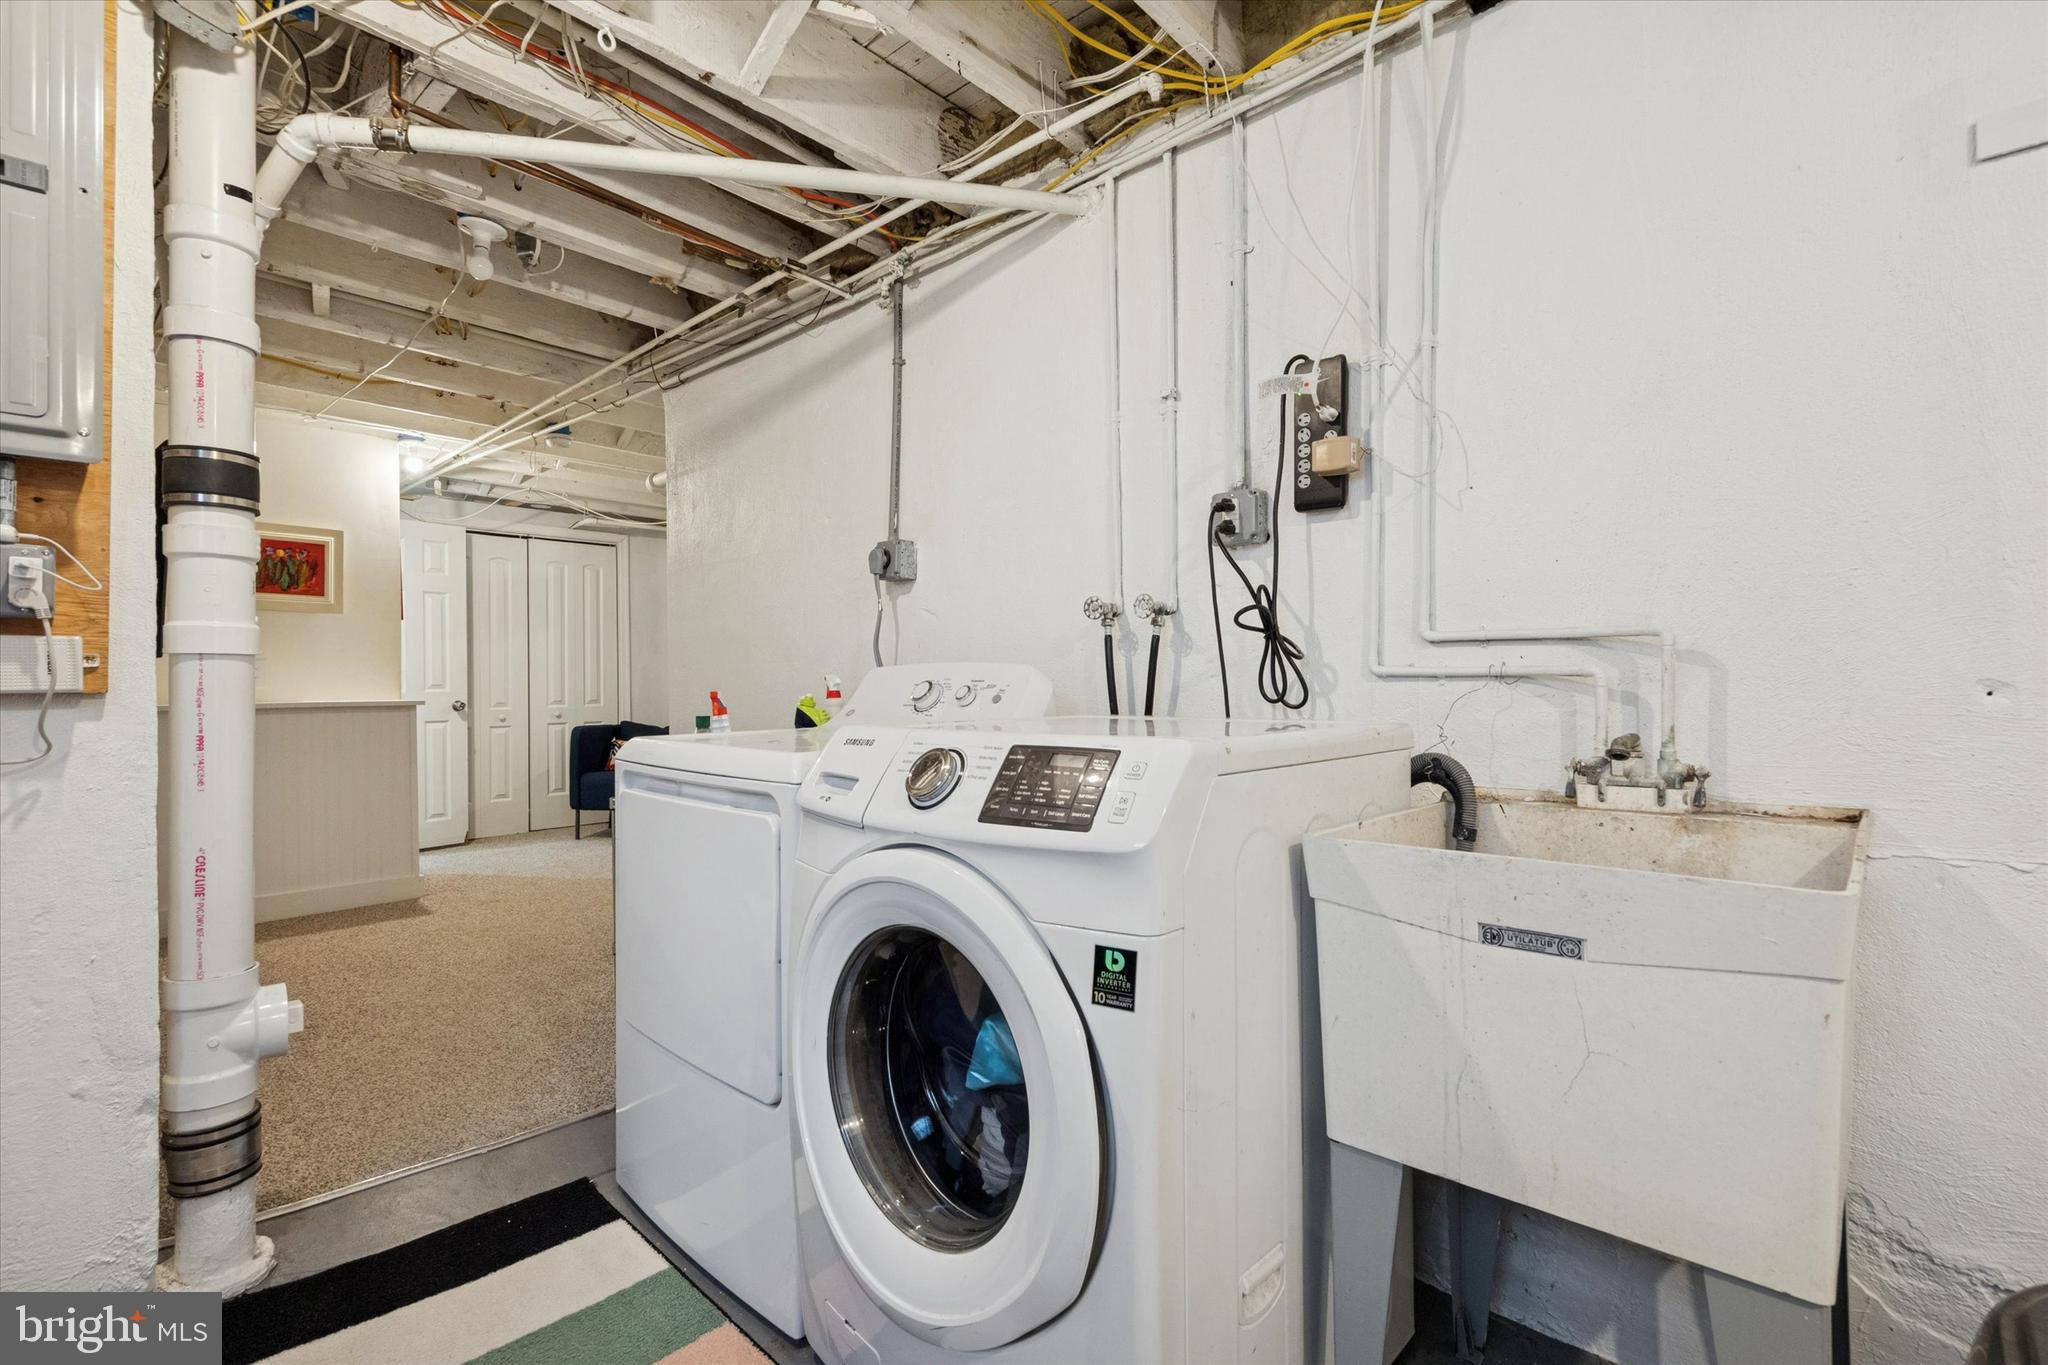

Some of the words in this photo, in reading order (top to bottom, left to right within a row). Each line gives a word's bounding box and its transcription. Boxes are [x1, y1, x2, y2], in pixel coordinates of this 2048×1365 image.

[843, 738, 875, 747] SAMSUNG
[1101, 971, 1127, 982] DIGITAL
[1097, 977, 1131, 988] INVERTER
[1094, 991, 1106, 1004] 10
[1106, 999, 1133, 1009] WARRANTY
